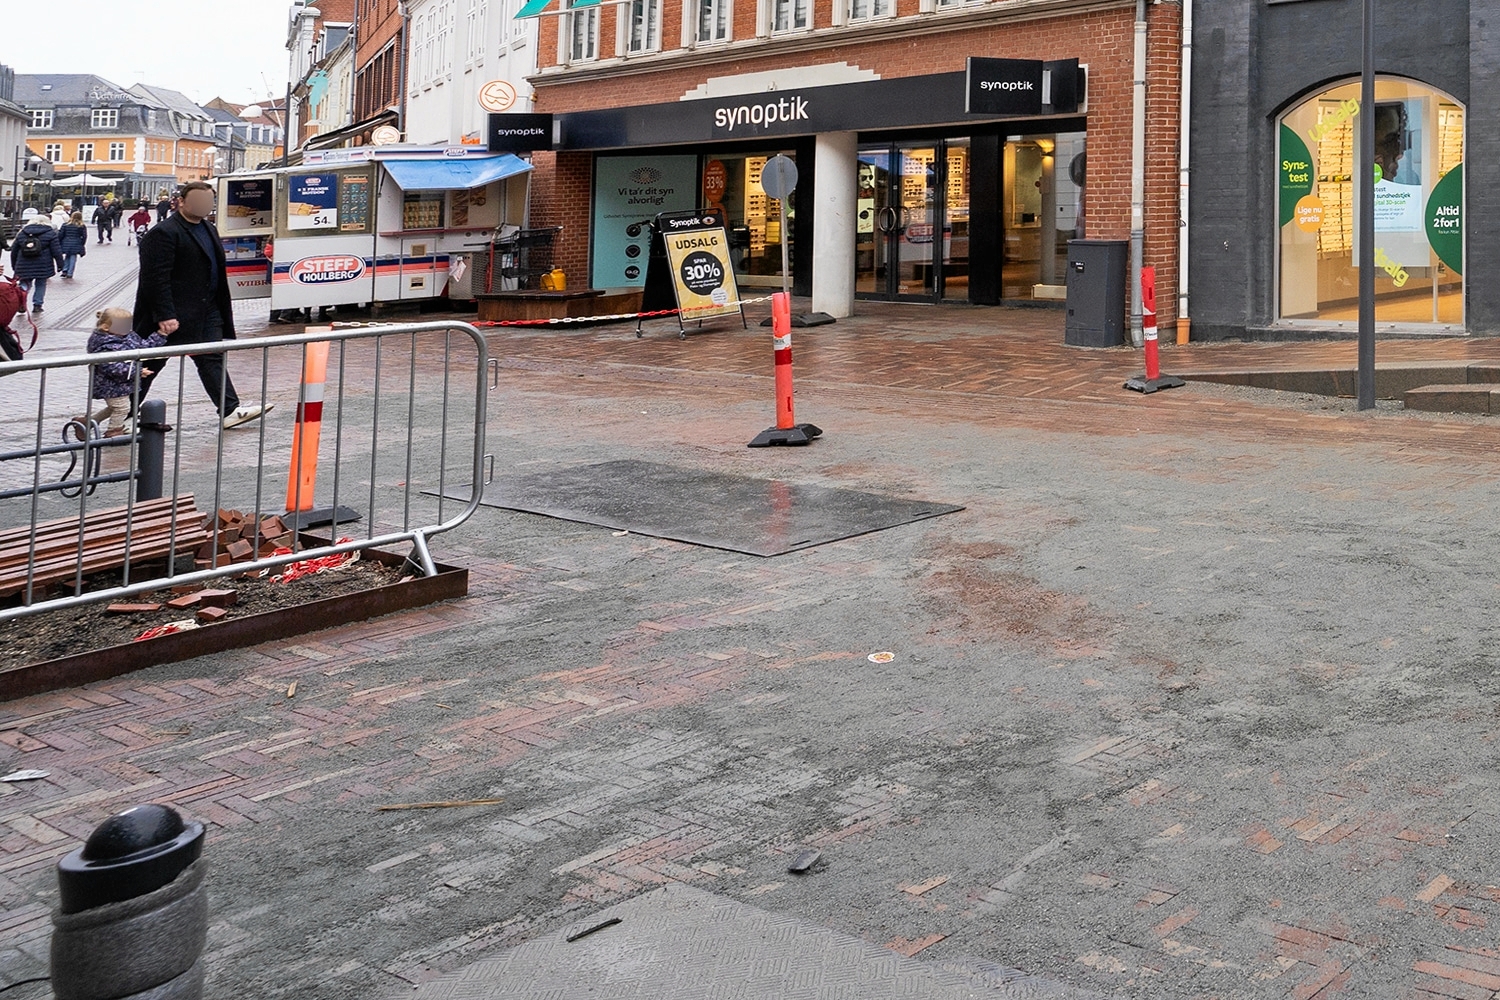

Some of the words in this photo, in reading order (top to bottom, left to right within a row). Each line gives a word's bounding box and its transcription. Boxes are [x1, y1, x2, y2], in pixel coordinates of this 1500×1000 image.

[980, 81, 1033, 91] synoptik
[715, 96, 809, 131] synoptik
[1308, 97, 1361, 142] Udsalg
[498, 128, 545, 136] synoptik
[1282, 160, 1309, 172] Syns-
[706, 176, 724, 189] 33%
[1289, 172, 1308, 182] test
[629, 187, 643, 195] ta'r
[645, 187, 657, 195] dit
[658, 188, 674, 197] syn
[628, 196, 664, 205] alvorligt
[1297, 206, 1311, 215] Lige
[1436, 205, 1459, 216] Altid
[250, 217, 264, 226] 54
[314, 216, 328, 225] 54
[670, 217, 700, 228] Synoptik
[1300, 215, 1320, 224] gratis
[675, 236, 718, 249] UDSALG
[302, 258, 355, 272] STEFF
[303, 270, 355, 282] HOULBERG
[684, 262, 721, 280] 30%
